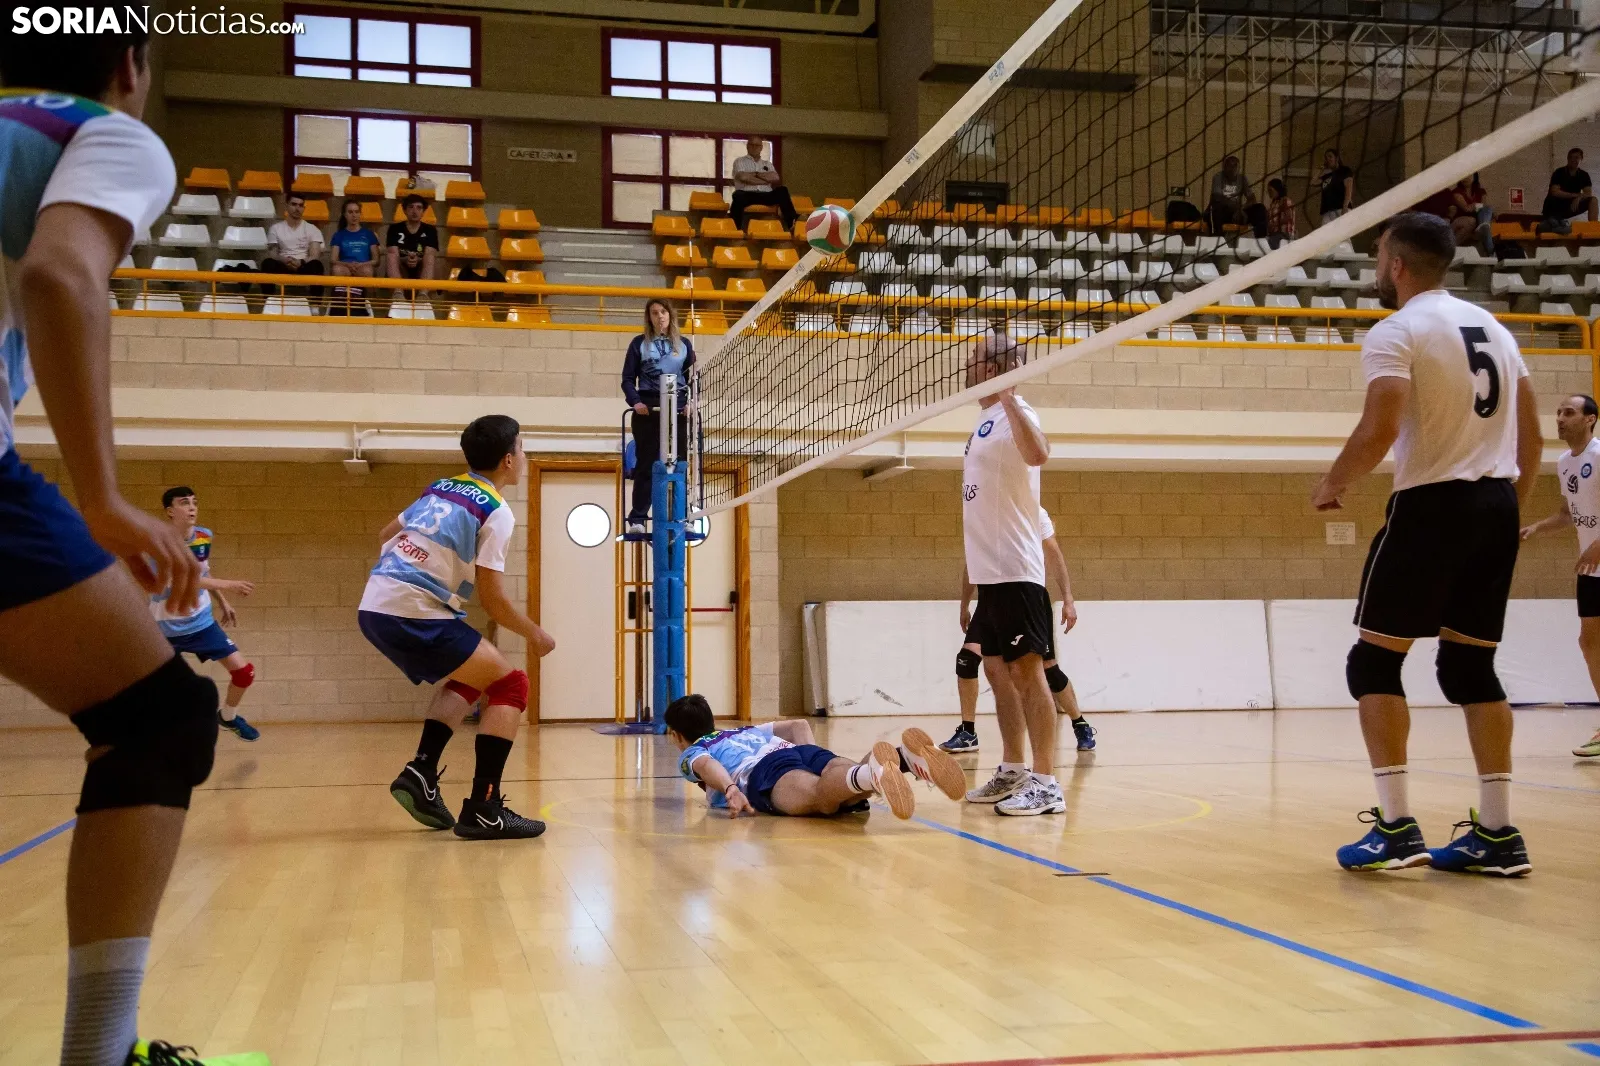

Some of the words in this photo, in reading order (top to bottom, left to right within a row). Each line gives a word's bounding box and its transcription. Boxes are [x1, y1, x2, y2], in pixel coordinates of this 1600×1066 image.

[509, 149, 564, 160] CAFETERIA
[397, 232, 405, 244] 2
[1458, 326, 1501, 418] 5
[450, 483, 490, 505] DUERO
[407, 496, 453, 535] 23
